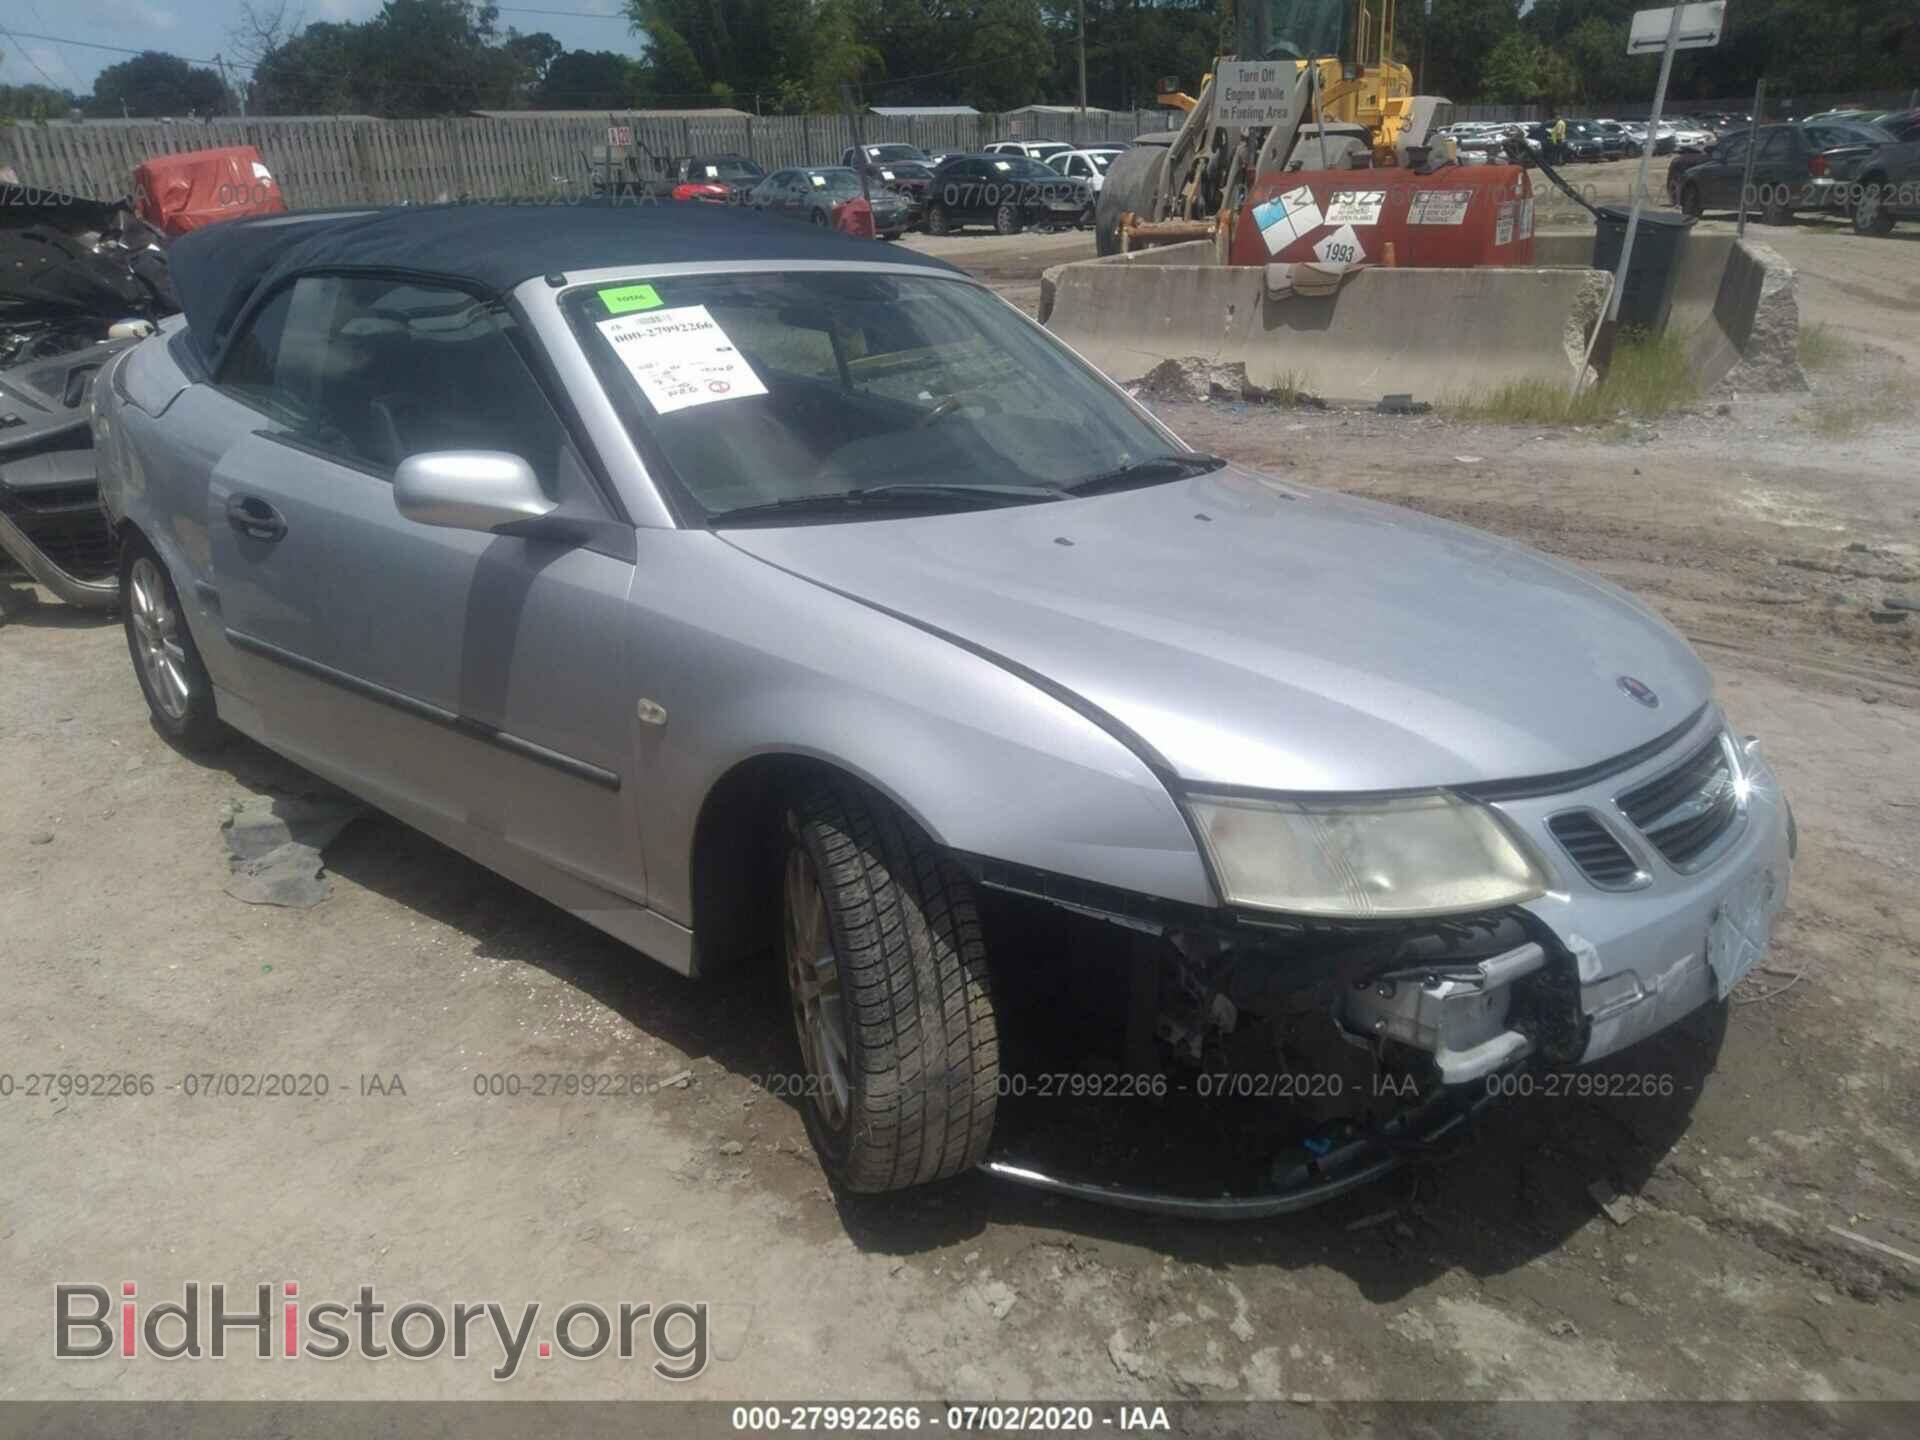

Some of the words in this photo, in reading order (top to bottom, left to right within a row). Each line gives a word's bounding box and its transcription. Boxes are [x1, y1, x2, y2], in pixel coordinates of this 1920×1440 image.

[1239, 68, 1259, 82] Turn
[1262, 68, 1276, 82] Off
[1225, 87, 1256, 103] Engine
[1258, 87, 1285, 100] While
[1231, 105, 1264, 121] Fueling
[1266, 106, 1288, 119] Area
[1325, 242, 1355, 263] 1993
